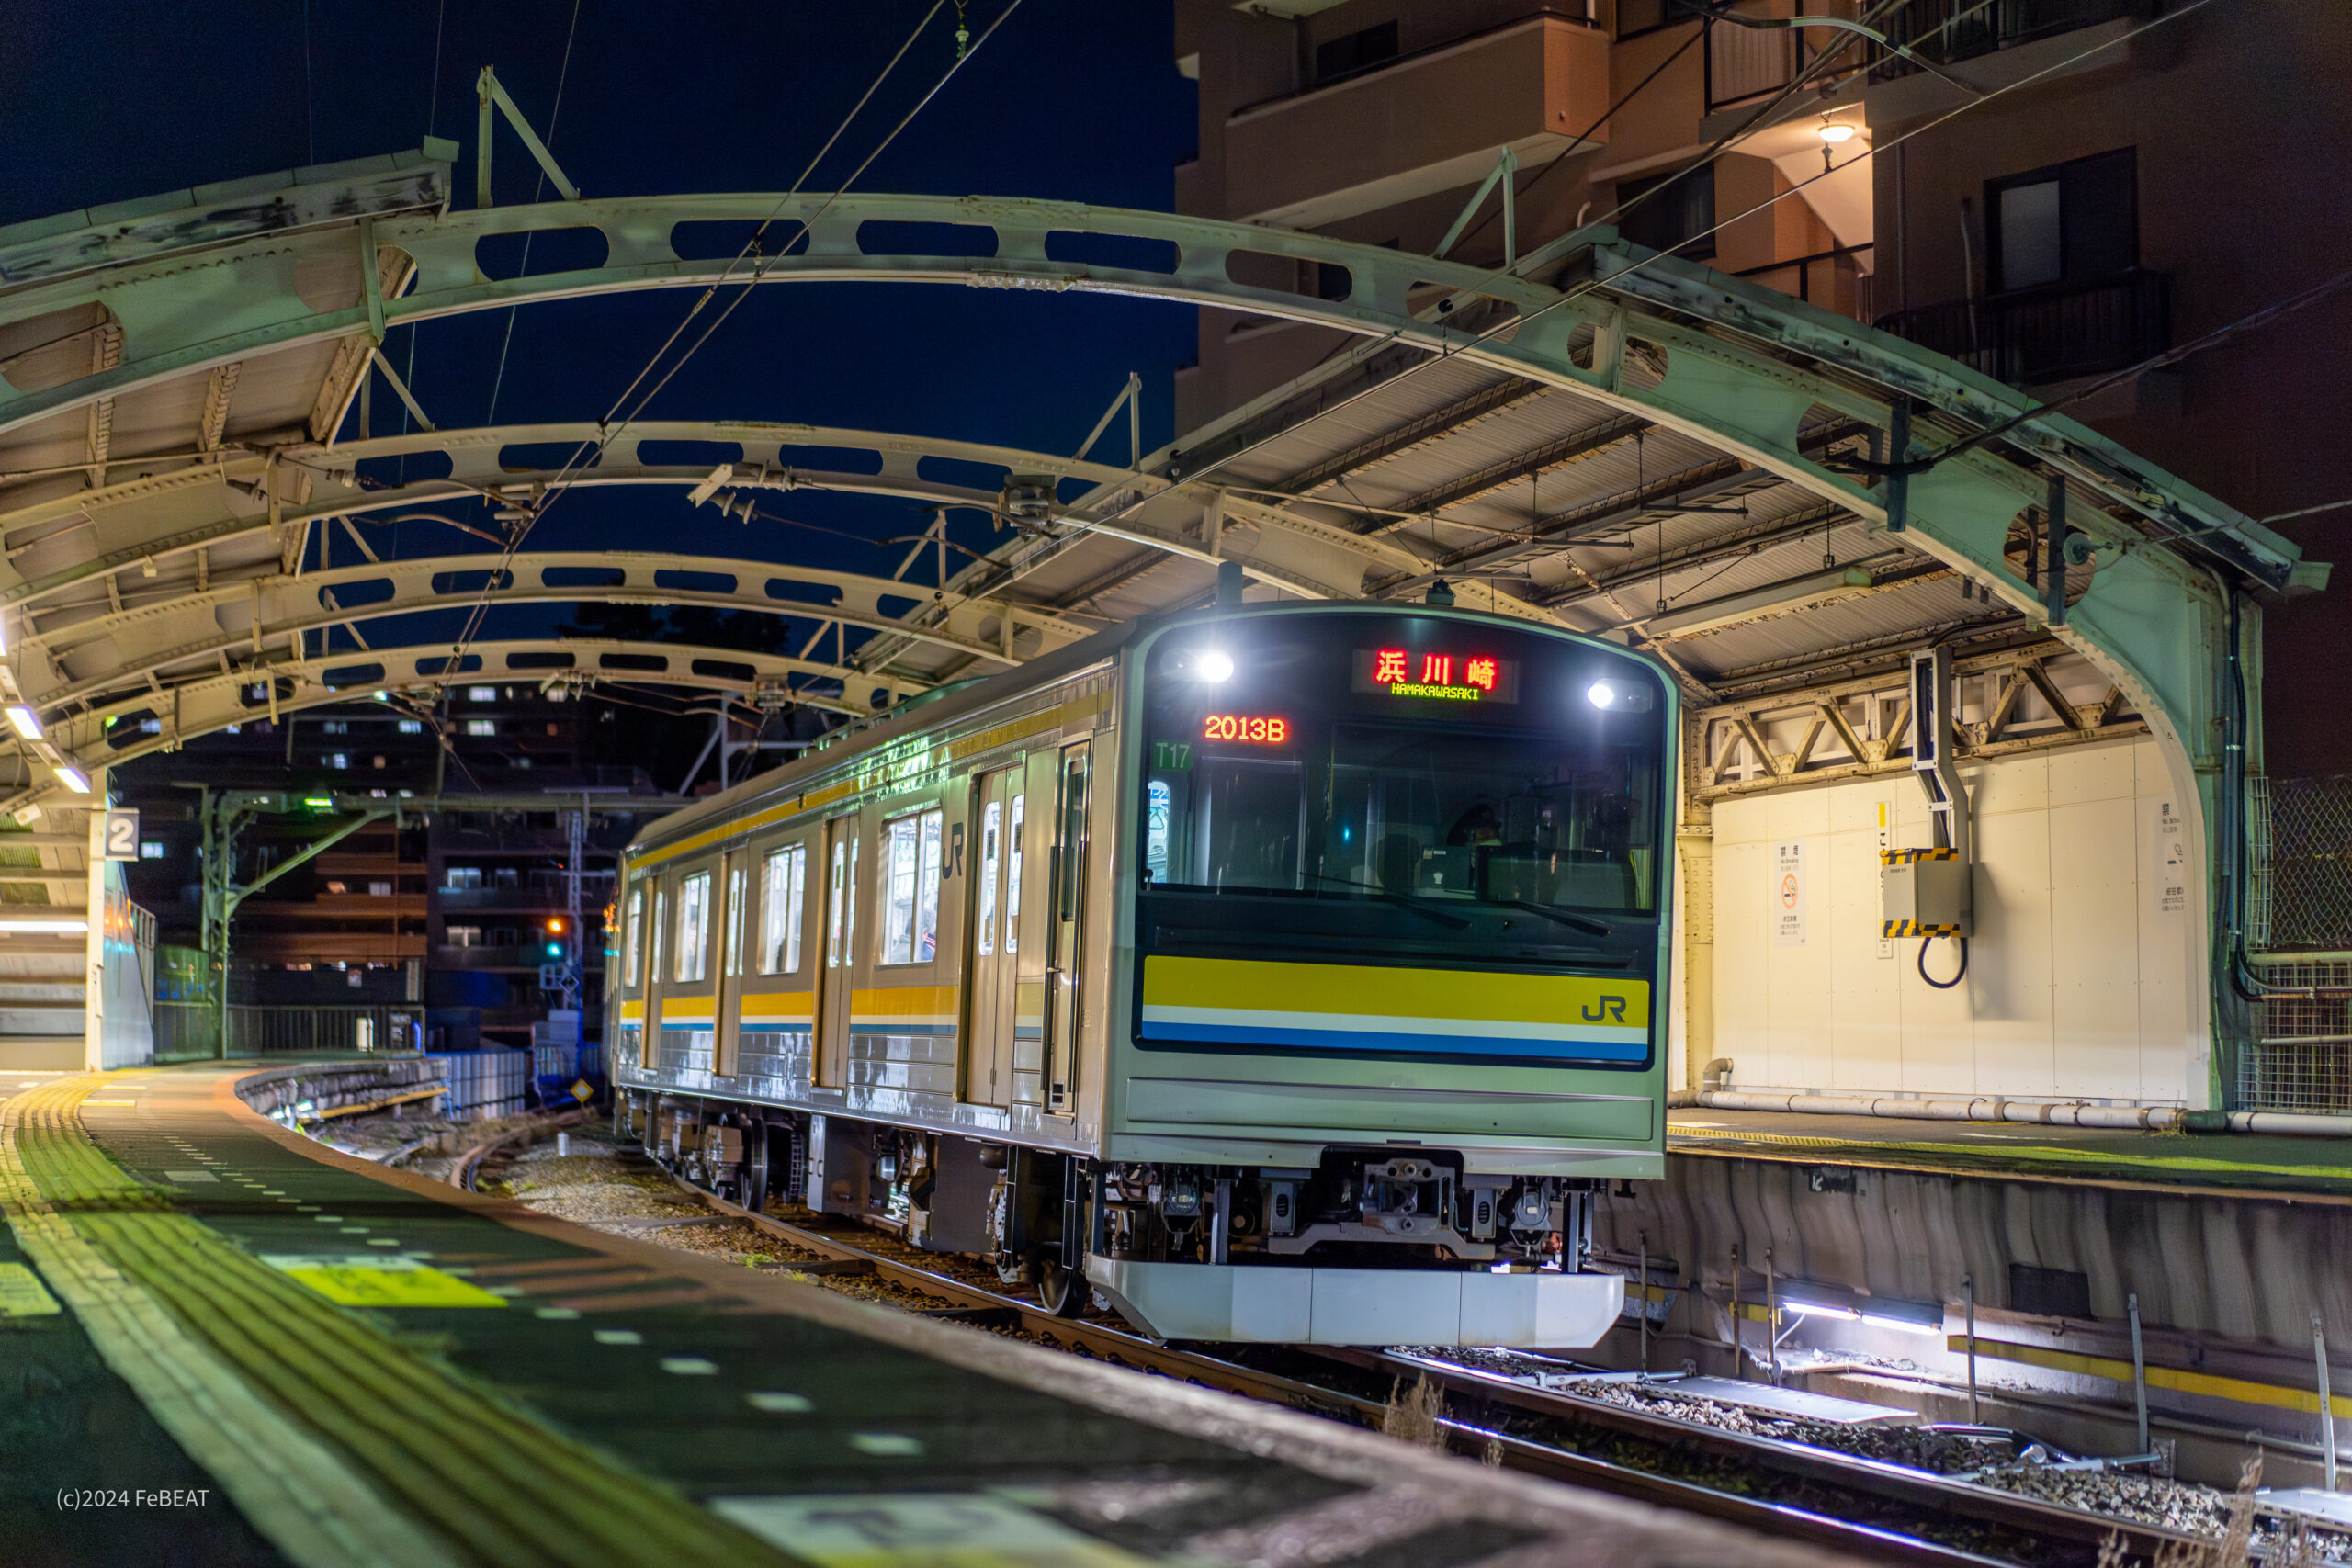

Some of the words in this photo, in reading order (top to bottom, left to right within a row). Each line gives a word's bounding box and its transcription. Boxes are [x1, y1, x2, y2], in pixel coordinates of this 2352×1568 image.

[1374, 649, 1497, 691] 浜川崎
[1391, 682, 1479, 701] HAMAKAWASAKI
[1204, 715, 1286, 743] 2013B
[1156, 742, 1190, 768] T17
[109, 818, 134, 852] 2
[942, 822, 964, 879] JR
[1581, 995, 1627, 1023] JR
